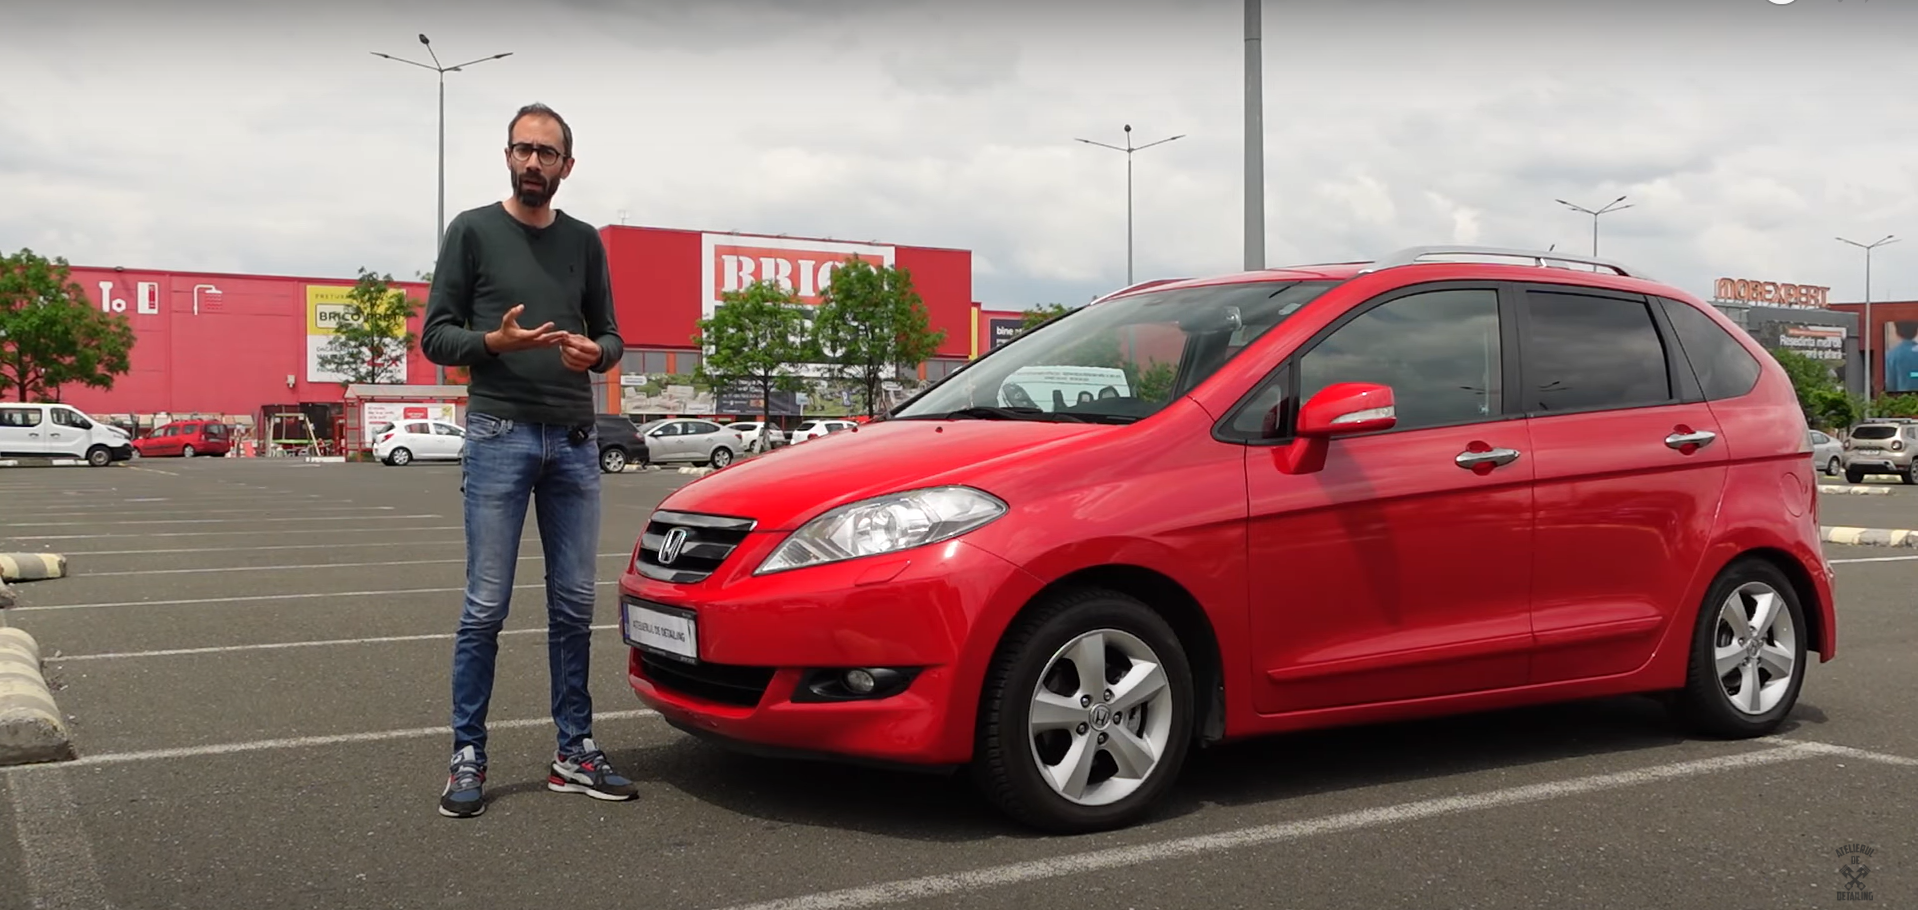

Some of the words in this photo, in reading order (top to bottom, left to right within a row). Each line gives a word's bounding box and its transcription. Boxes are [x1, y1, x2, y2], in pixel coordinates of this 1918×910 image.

[721, 254, 878, 298] BRIC
[1715, 277, 1831, 307] MOBEXPERT
[319, 311, 361, 322] BRICO
[996, 325, 1014, 336] bine
